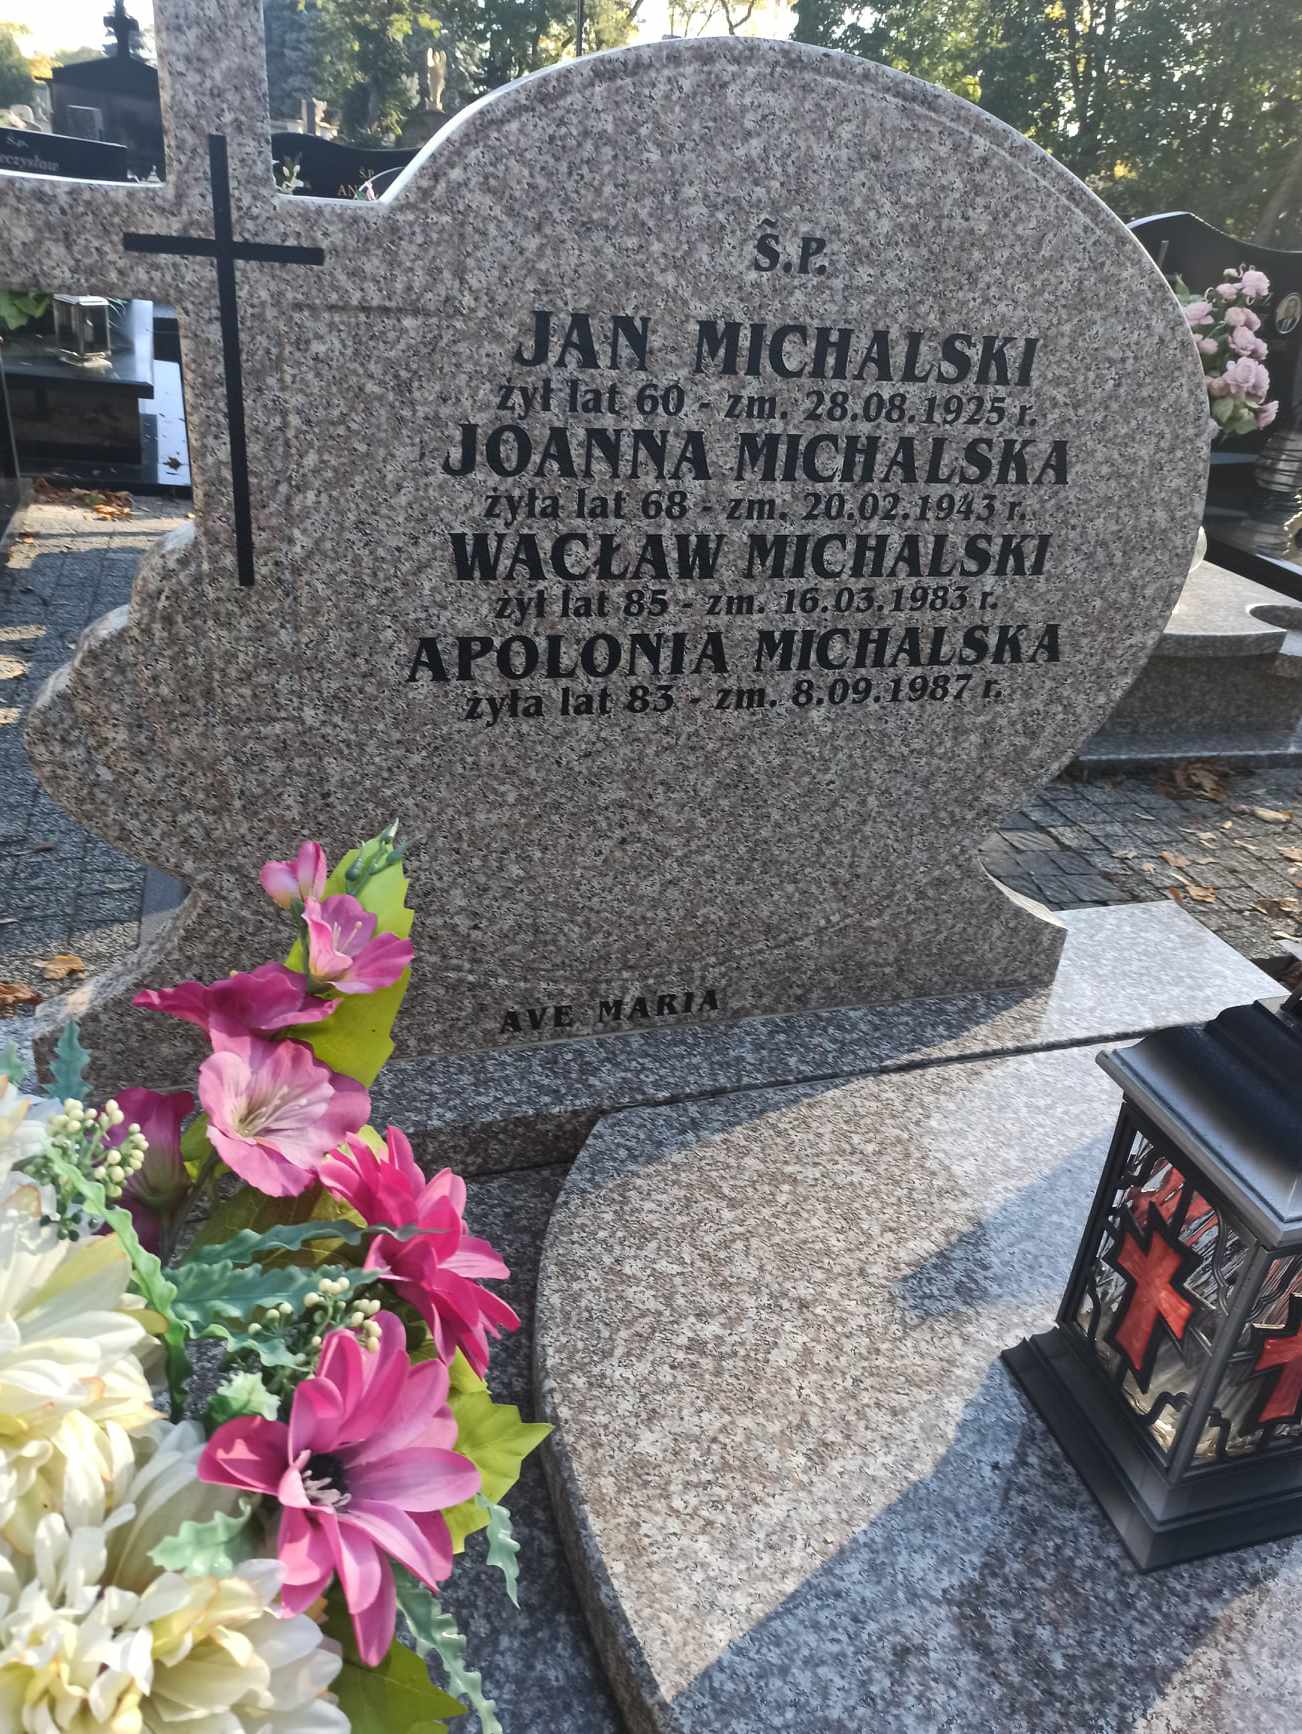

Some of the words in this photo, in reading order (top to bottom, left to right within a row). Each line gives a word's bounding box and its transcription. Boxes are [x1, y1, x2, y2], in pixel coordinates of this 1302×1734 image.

[513, 310, 651, 371] JAN
[695, 320, 1040, 387] MICHALSKI
[497, 377, 554, 420] żył
[568, 378, 621, 417] lat
[637, 382, 685, 417] 60
[724, 394, 789, 420] zm.
[804, 390, 1007, 426] 28.08.1925
[1015, 404, 1037, 427] r.
[442, 423, 712, 480] JOANNA
[734, 432, 1069, 485] MICHALSKA
[484, 487, 560, 527] żyła
[575, 488, 628, 520] lat
[641, 490, 688, 520] 68
[726, 497, 789, 521] zm.
[802, 493, 996, 521] 20.02.1943
[1006, 501, 1027, 521] r.
[449, 532, 727, 581] WACŁAW
[744, 533, 1051, 579] MICHALSKI
[561, 588, 609, 618] lat
[624, 588, 668, 617] 85
[705, 593, 765, 616] zm.
[784, 586, 969, 614] 16.03.1983
[978, 591, 998, 610] r.
[406, 631, 729, 682] APOLONIA
[754, 623, 1061, 672] MICHALSKA
[464, 688, 544, 727] żyła
[560, 687, 612, 716] lat
[627, 684, 675, 713] 83
[715, 685, 777, 709] zm.
[792, 674, 973, 707] 8.09.1987
[983, 679, 1002, 699] r.
[501, 1005, 574, 1034] AVE
[597, 989, 719, 1022] MARIA
